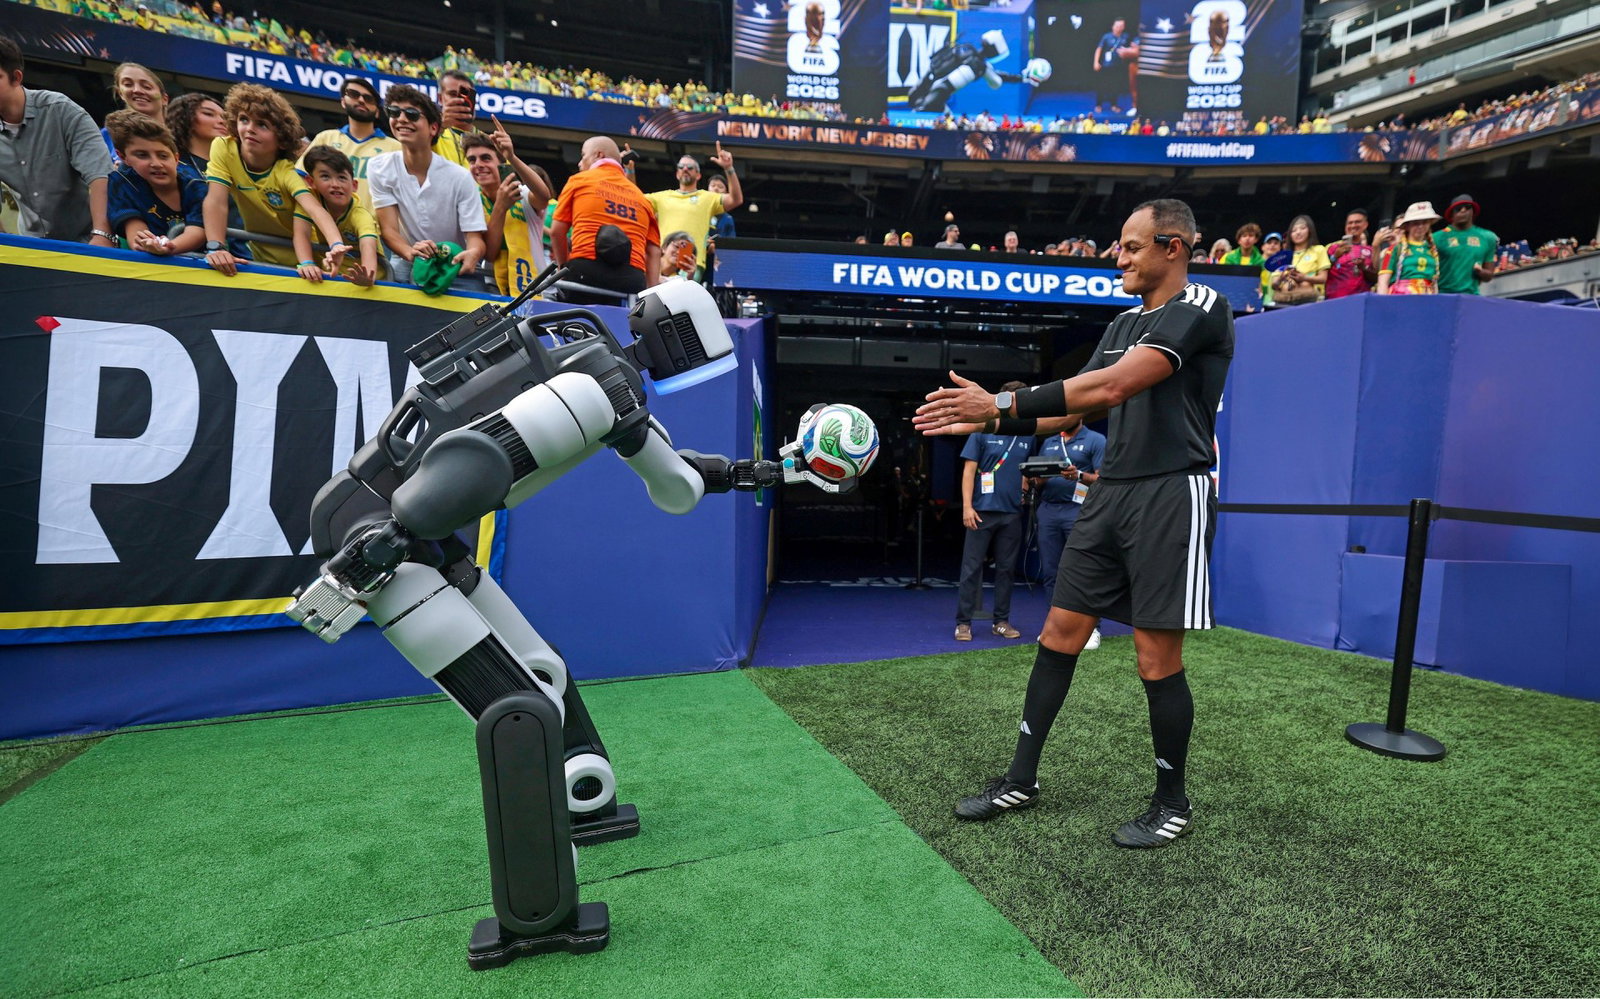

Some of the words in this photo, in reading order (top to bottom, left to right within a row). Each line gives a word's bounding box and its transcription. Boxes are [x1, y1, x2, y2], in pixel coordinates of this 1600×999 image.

[226, 52, 293, 84] FIFA
[803, 57, 826, 66] FIFA
[1205, 67, 1228, 75] FIFA
[787, 74, 821, 86] WORLD
[821, 76, 840, 87] CUP
[786, 83, 840, 100] 2026
[1187, 85, 1222, 96] WORLD
[1222, 84, 1243, 95] CUP
[475, 92, 547, 119] 026
[1186, 93, 1242, 109] 2026
[1211, 110, 1243, 121] YORK
[717, 120, 761, 139] NEW
[763, 123, 814, 142] YORK
[816, 127, 859, 145] NEW
[860, 130, 930, 150] JERSEY
[1166, 142, 1255, 160] #FIFAWorldCup
[604, 199, 638, 222] 381
[833, 262, 894, 287] FIFA
[898, 266, 1001, 291] WORLD
[1005, 271, 1060, 294] CUP
[1064, 274, 1143, 299] 202
